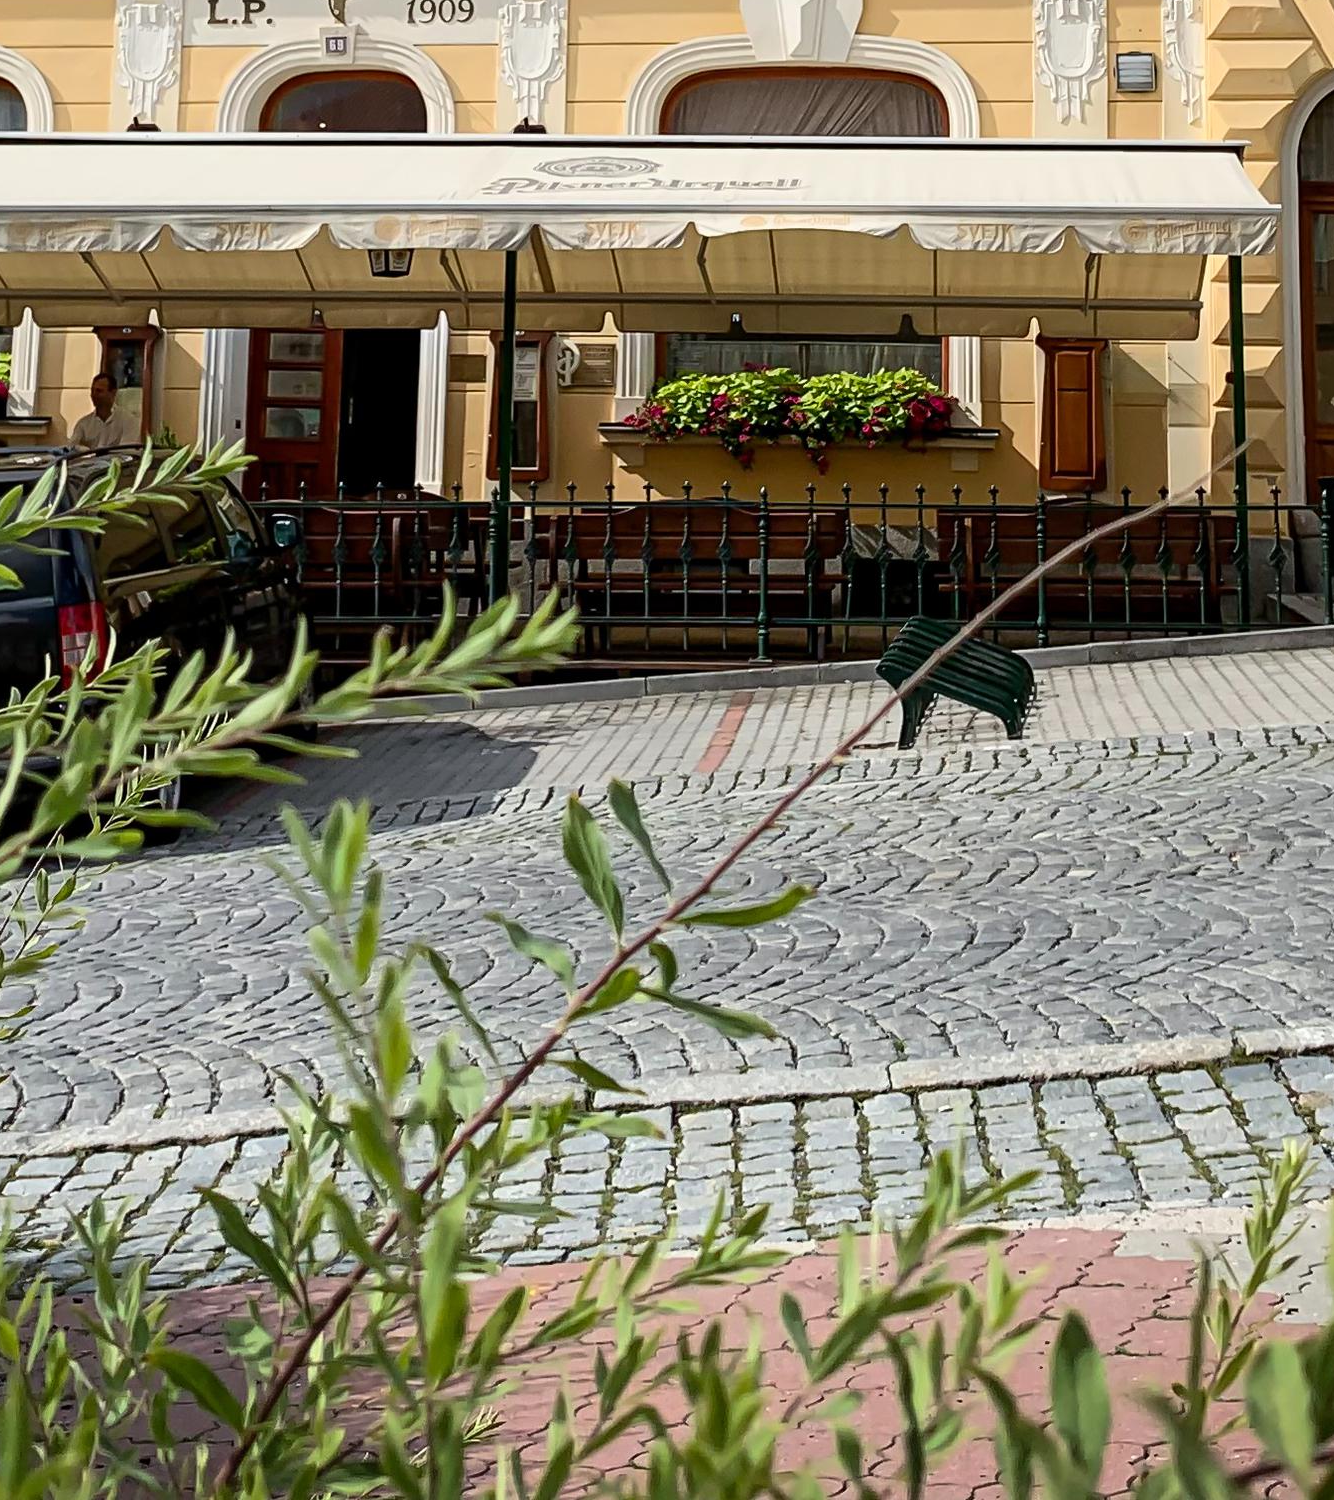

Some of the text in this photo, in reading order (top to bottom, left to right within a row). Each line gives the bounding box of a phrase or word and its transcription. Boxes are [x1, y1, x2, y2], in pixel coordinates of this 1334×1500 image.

[329, 39, 344, 51] 69
[482, 177, 803, 195] Pilsner Urquell
